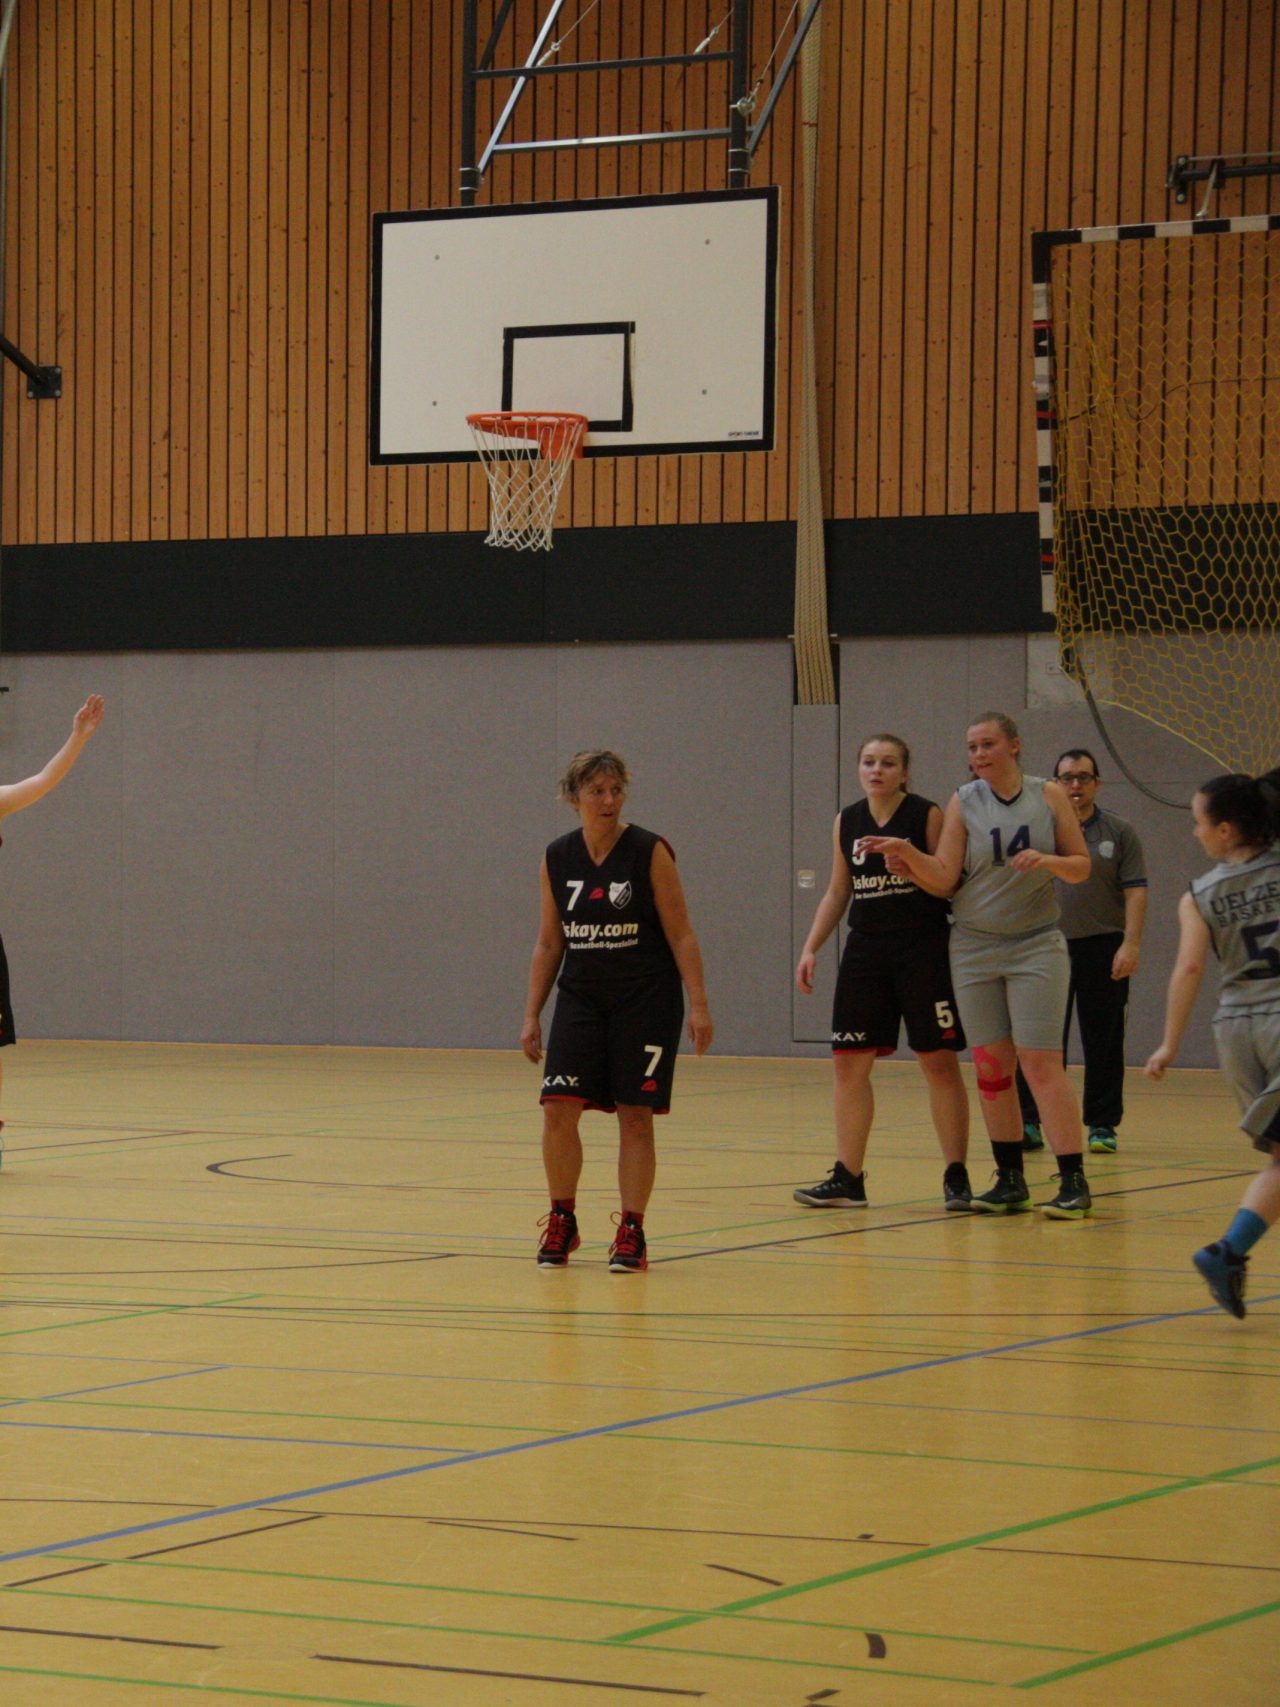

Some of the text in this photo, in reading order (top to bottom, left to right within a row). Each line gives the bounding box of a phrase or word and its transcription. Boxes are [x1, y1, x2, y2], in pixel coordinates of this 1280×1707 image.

[990, 824, 1030, 867] 14
[566, 880, 585, 912] 7
[1240, 919, 1280, 980] 5
[935, 1000, 954, 1029] 5
[644, 1044, 663, 1077] 7
